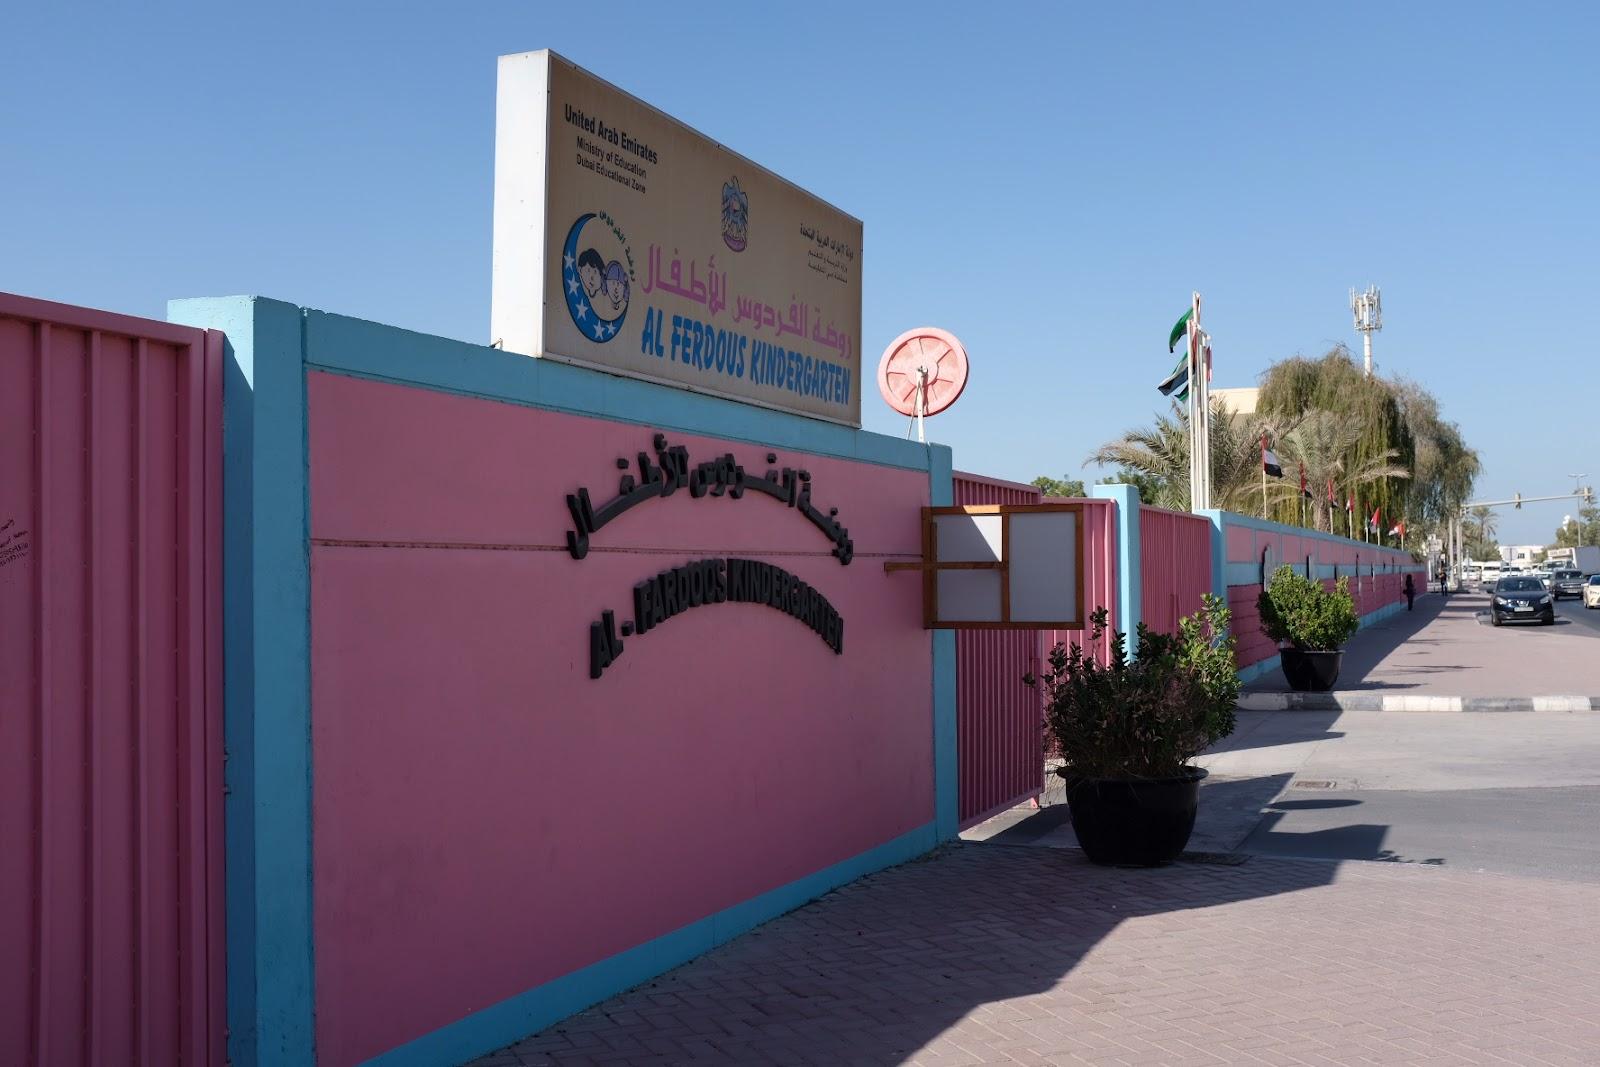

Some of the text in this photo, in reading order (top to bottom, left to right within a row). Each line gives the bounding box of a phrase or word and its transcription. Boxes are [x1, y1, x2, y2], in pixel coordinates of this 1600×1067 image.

[565, 104, 657, 165] United Arab Emirates
[577, 136, 647, 179] Ministry of Education
[577, 154, 646, 194] Dubai Educational Zone
[640, 244, 853, 359] روضة الفردوس للأطفال
[641, 306, 851, 405] AL FERDOUS KINDERGARTEN
[689, 453, 797, 507] الفردوس
[797, 470, 854, 565] روضة
[727, 558, 843, 655] KINDERGARTEN
